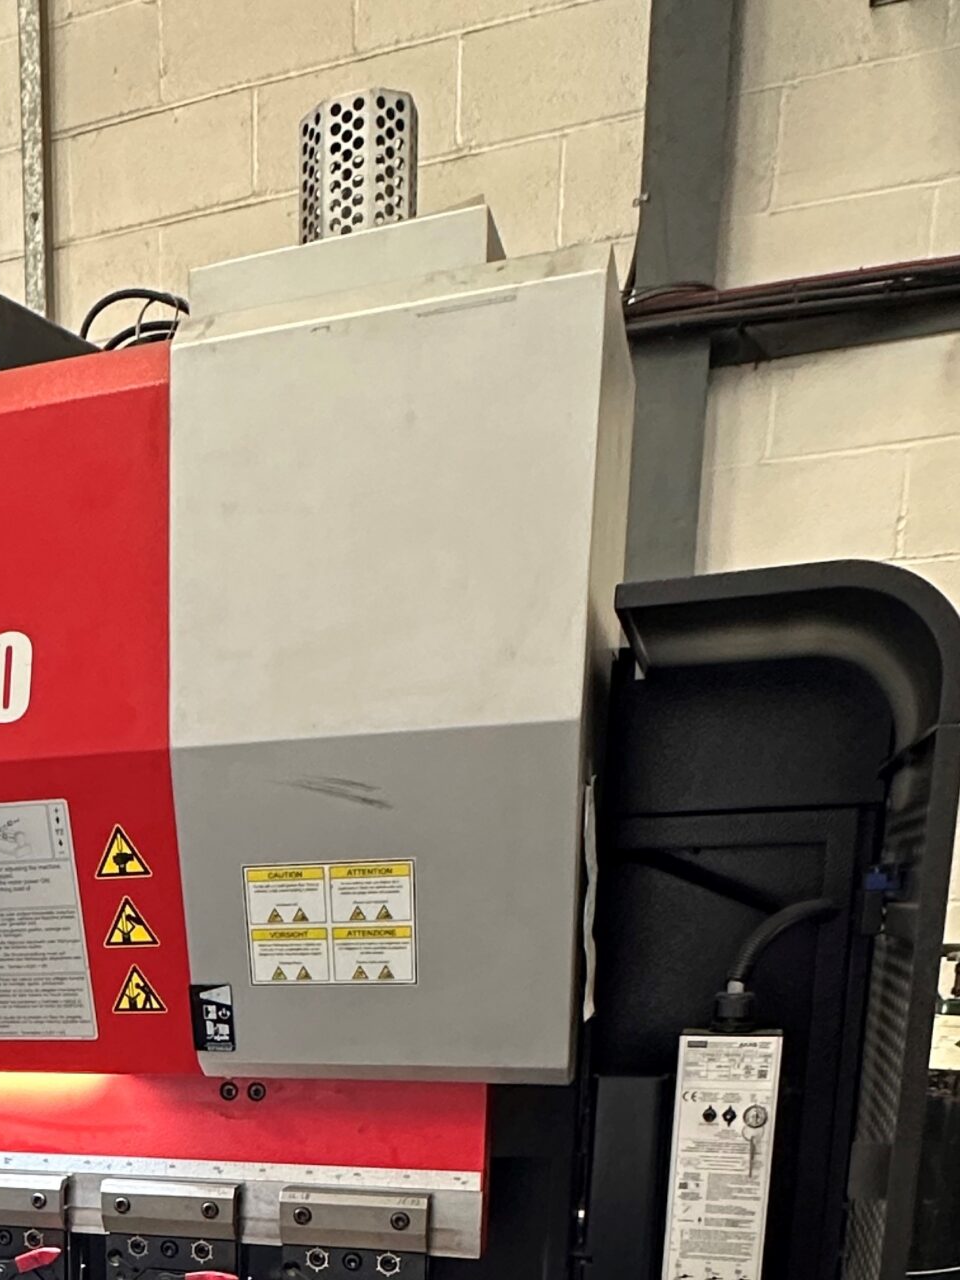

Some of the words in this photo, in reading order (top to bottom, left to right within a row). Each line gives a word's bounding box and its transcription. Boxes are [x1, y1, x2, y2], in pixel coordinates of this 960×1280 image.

[267, 871, 303, 879] CAUTION
[347, 868, 393, 876] ATTENTION
[347, 929, 397, 937] ATTENZIONE
